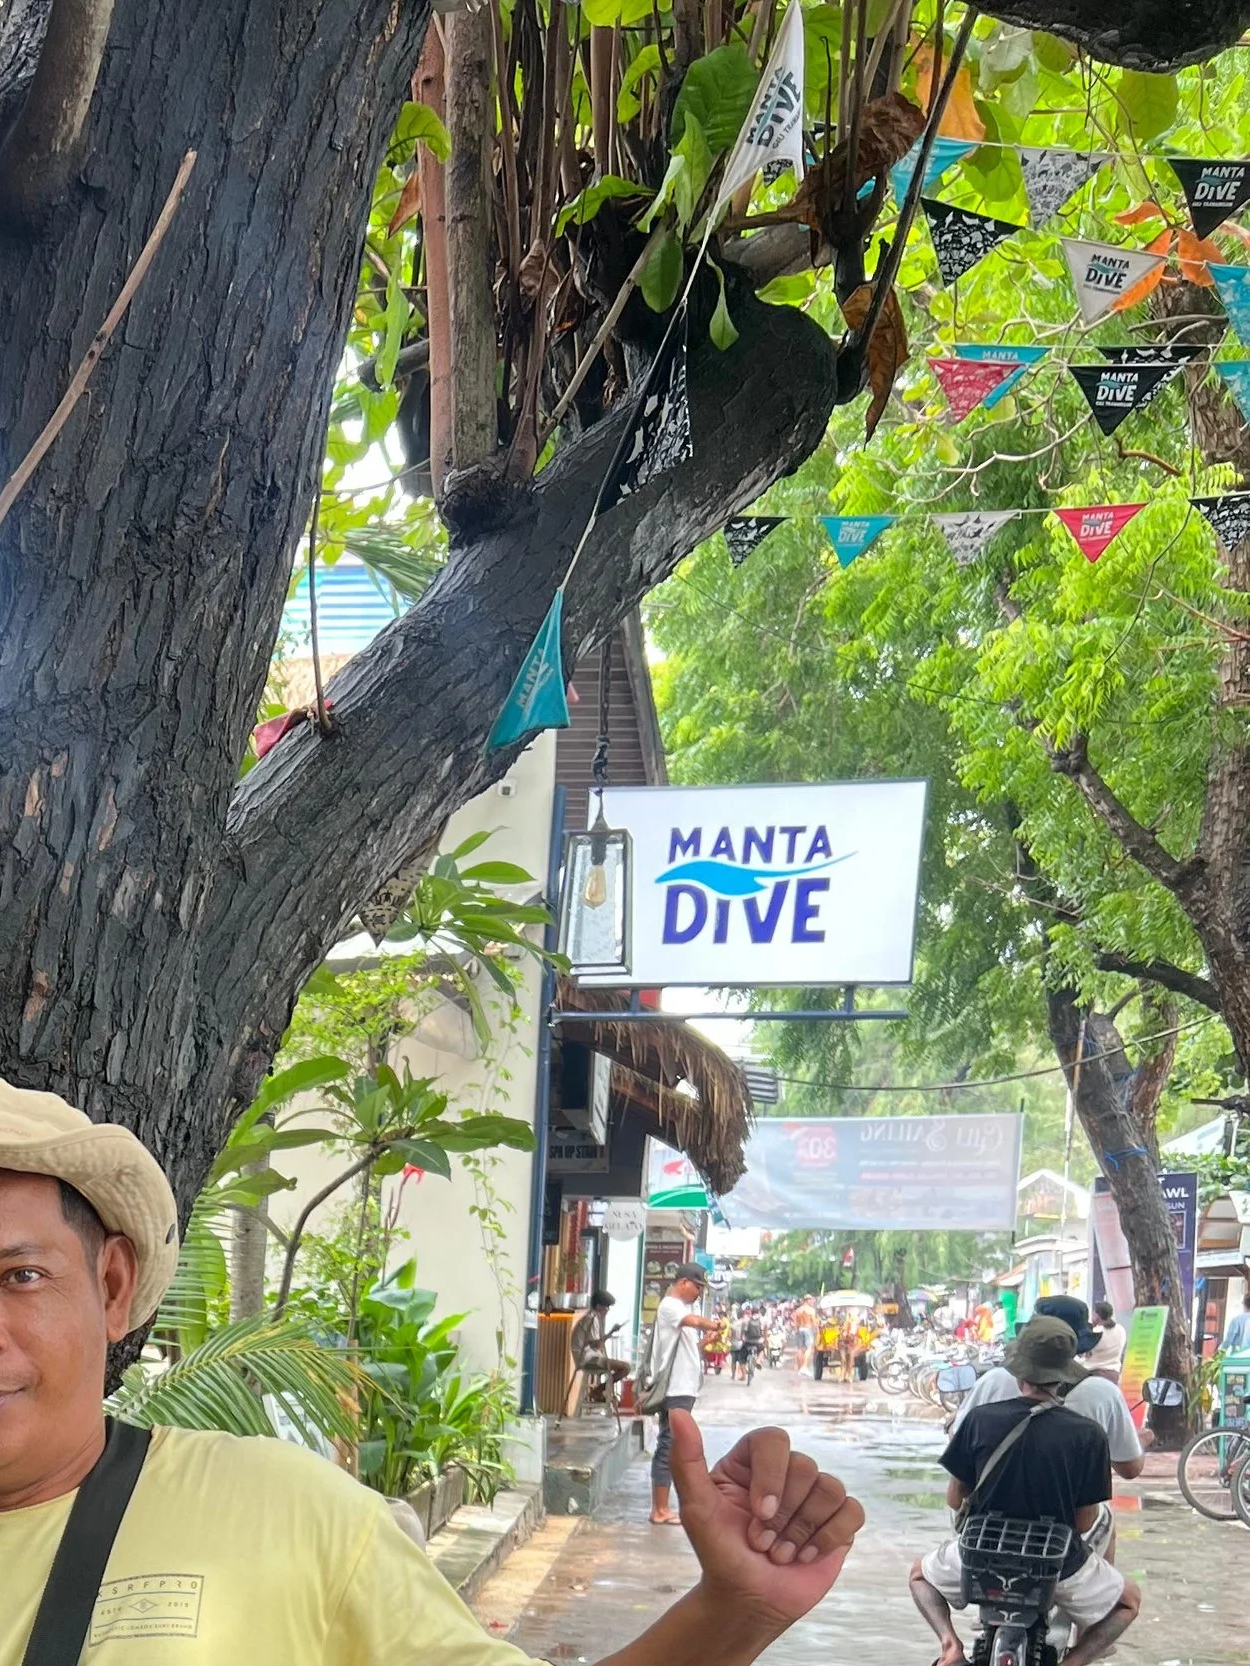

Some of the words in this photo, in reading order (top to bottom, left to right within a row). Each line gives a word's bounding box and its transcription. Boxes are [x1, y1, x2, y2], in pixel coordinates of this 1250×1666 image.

[757, 71, 801, 147] DIVE
[1201, 166, 1245, 179] MANTA
[1194, 181, 1241, 201] DIVE
[1090, 253, 1130, 270] MANTA
[1085, 267, 1127, 289] DIVE
[982, 350, 1019, 361] MANTA
[1100, 372, 1139, 383] MANTA
[1096, 384, 1137, 402] DIVE
[1081, 511, 1114, 521] MANTA
[1080, 520, 1113, 537] DIVE
[668, 825, 833, 865] MANTA
[662, 876, 831, 945] DIVE
